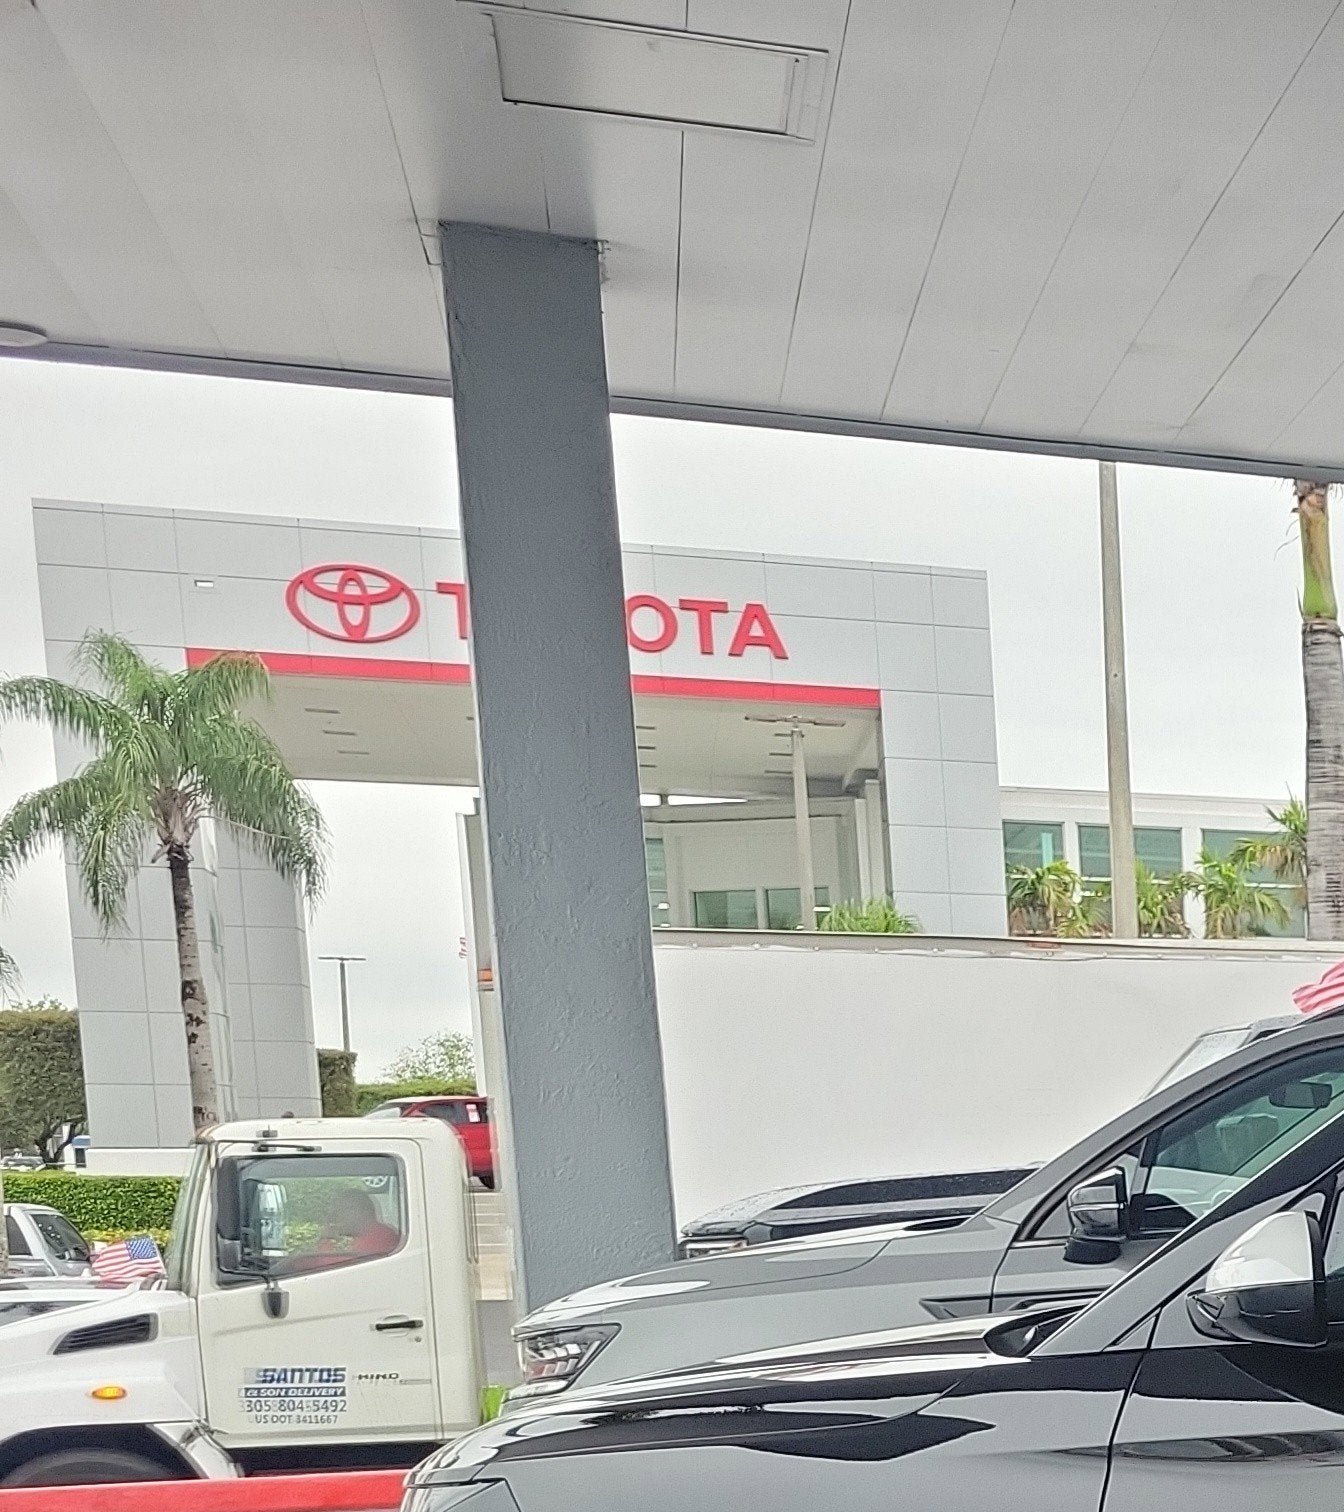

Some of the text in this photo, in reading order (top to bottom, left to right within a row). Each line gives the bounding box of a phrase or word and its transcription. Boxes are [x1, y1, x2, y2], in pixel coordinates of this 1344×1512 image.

[435, 581, 789, 660] TOTA
[261, 1367, 347, 1384] SANTOS
[357, 1372, 400, 1380] HINO
[259, 1388, 286, 1397] SON
[287, 1387, 344, 1397] DELIVERY
[255, 1414, 338, 1424] US DOT 3411667
